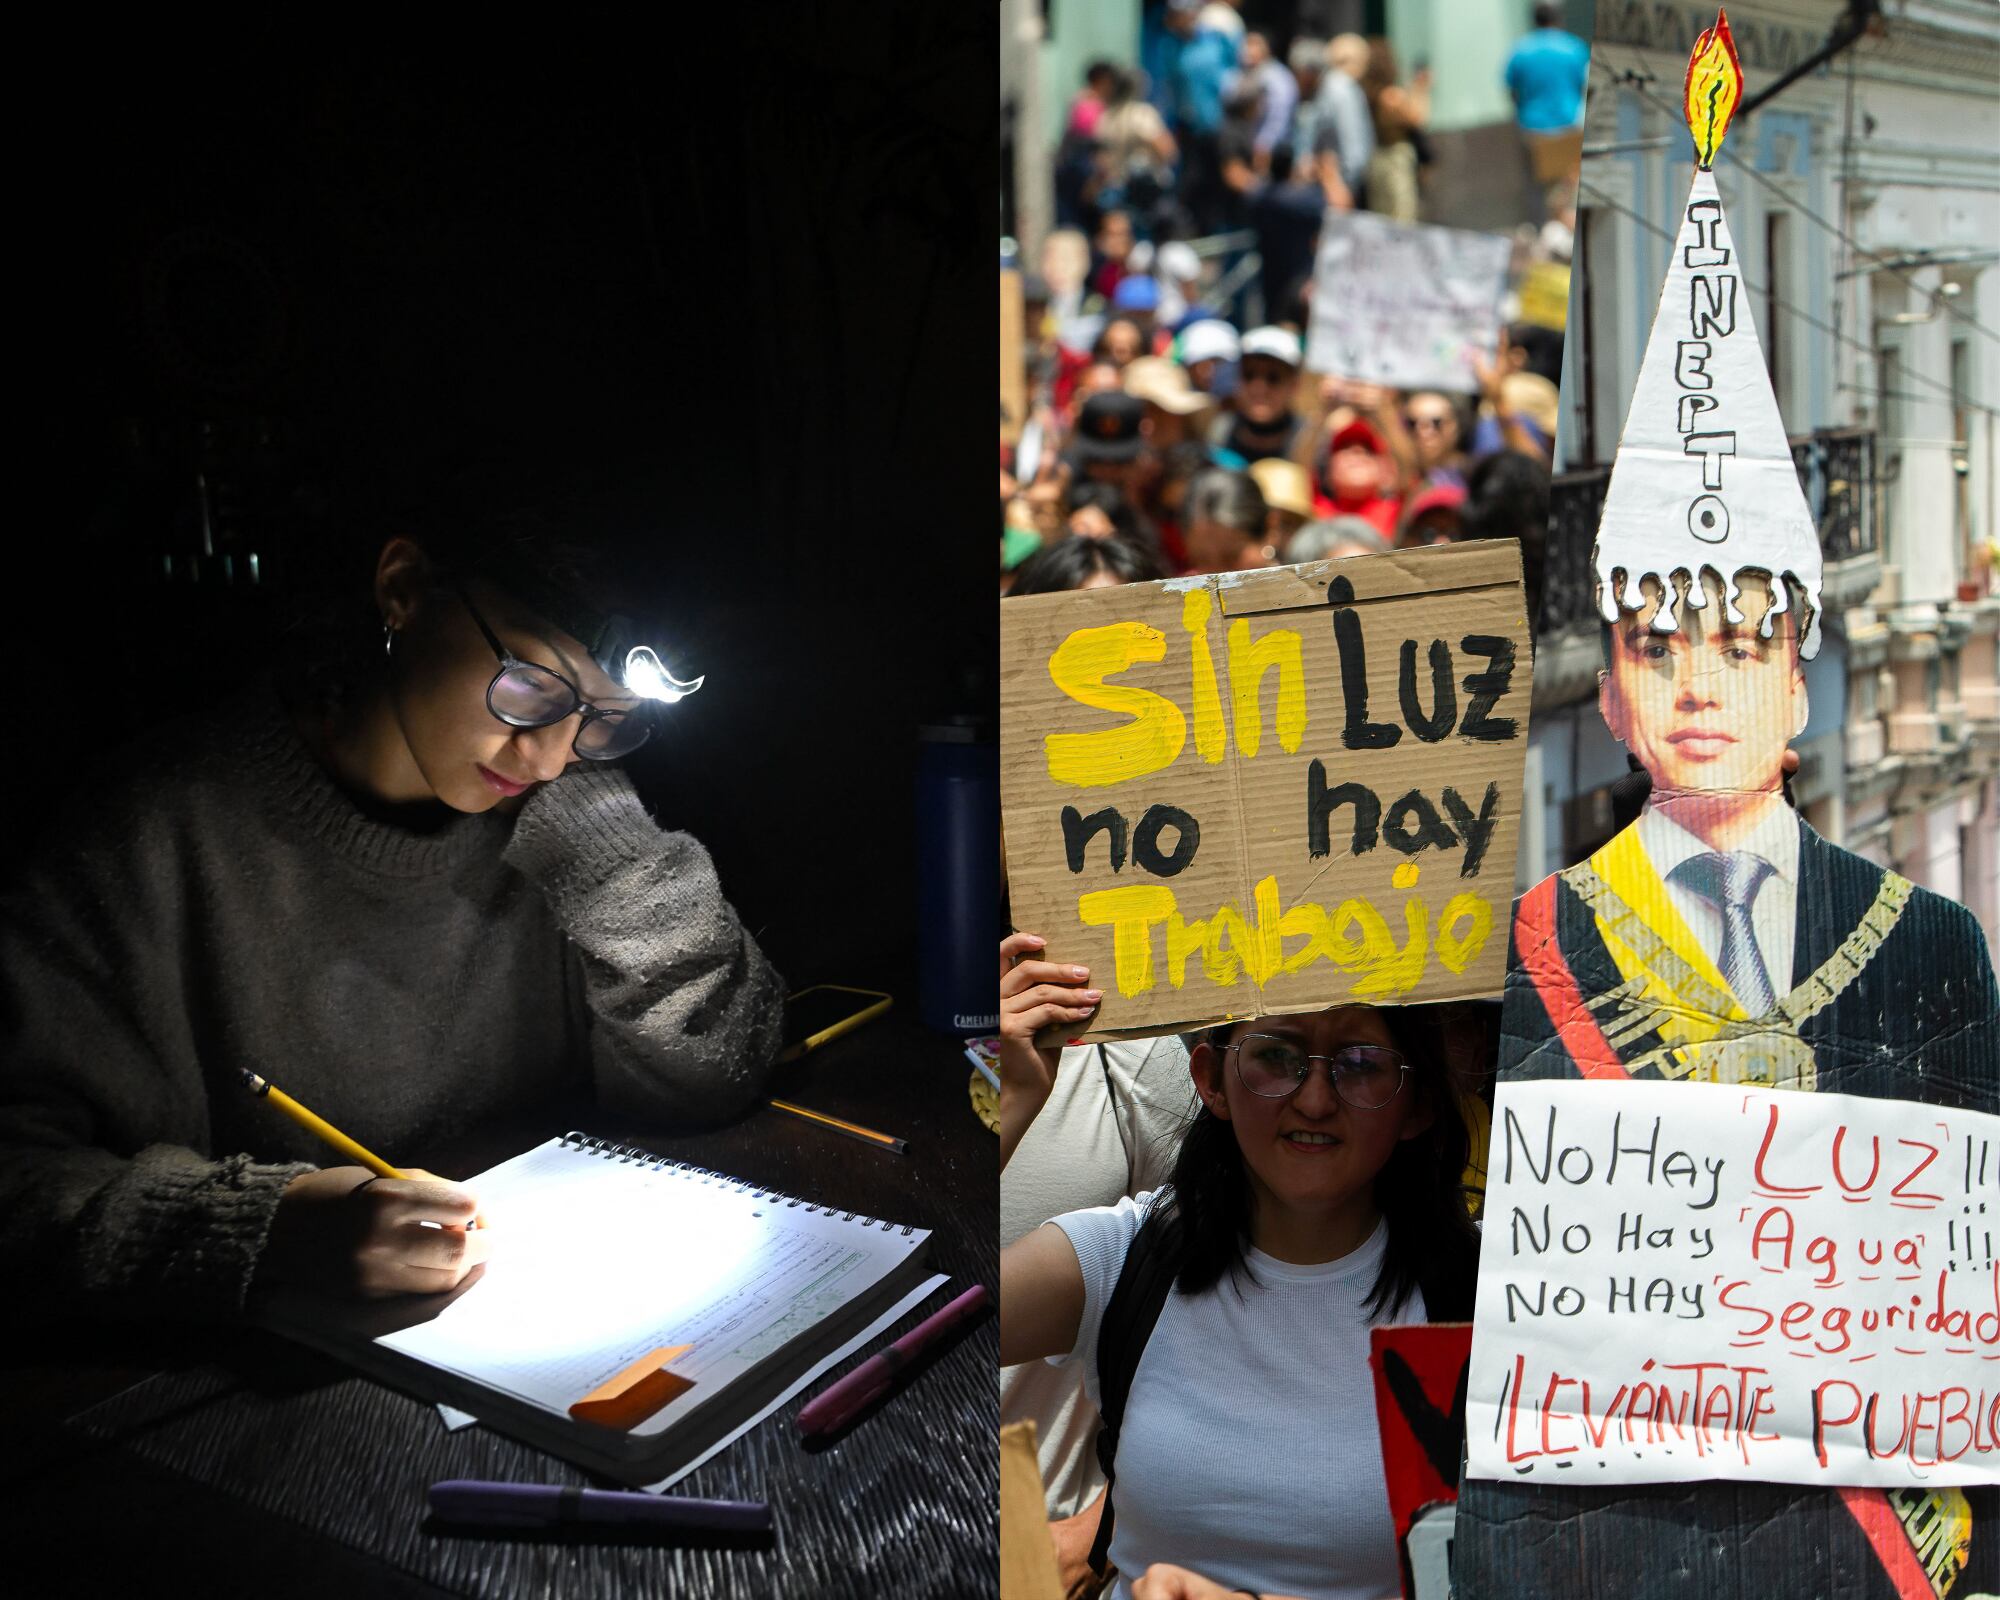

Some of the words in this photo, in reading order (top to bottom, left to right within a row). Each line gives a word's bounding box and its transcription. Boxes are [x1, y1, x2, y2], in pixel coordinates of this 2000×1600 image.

[1674, 199, 1738, 544] INEPTO
[1044, 588, 1308, 788] Sin
[1061, 803, 1201, 877] no
[1308, 758, 1500, 879] hay
[1078, 861, 1495, 1002] Trabajo
[1617, 1211, 1715, 1259] Hay
